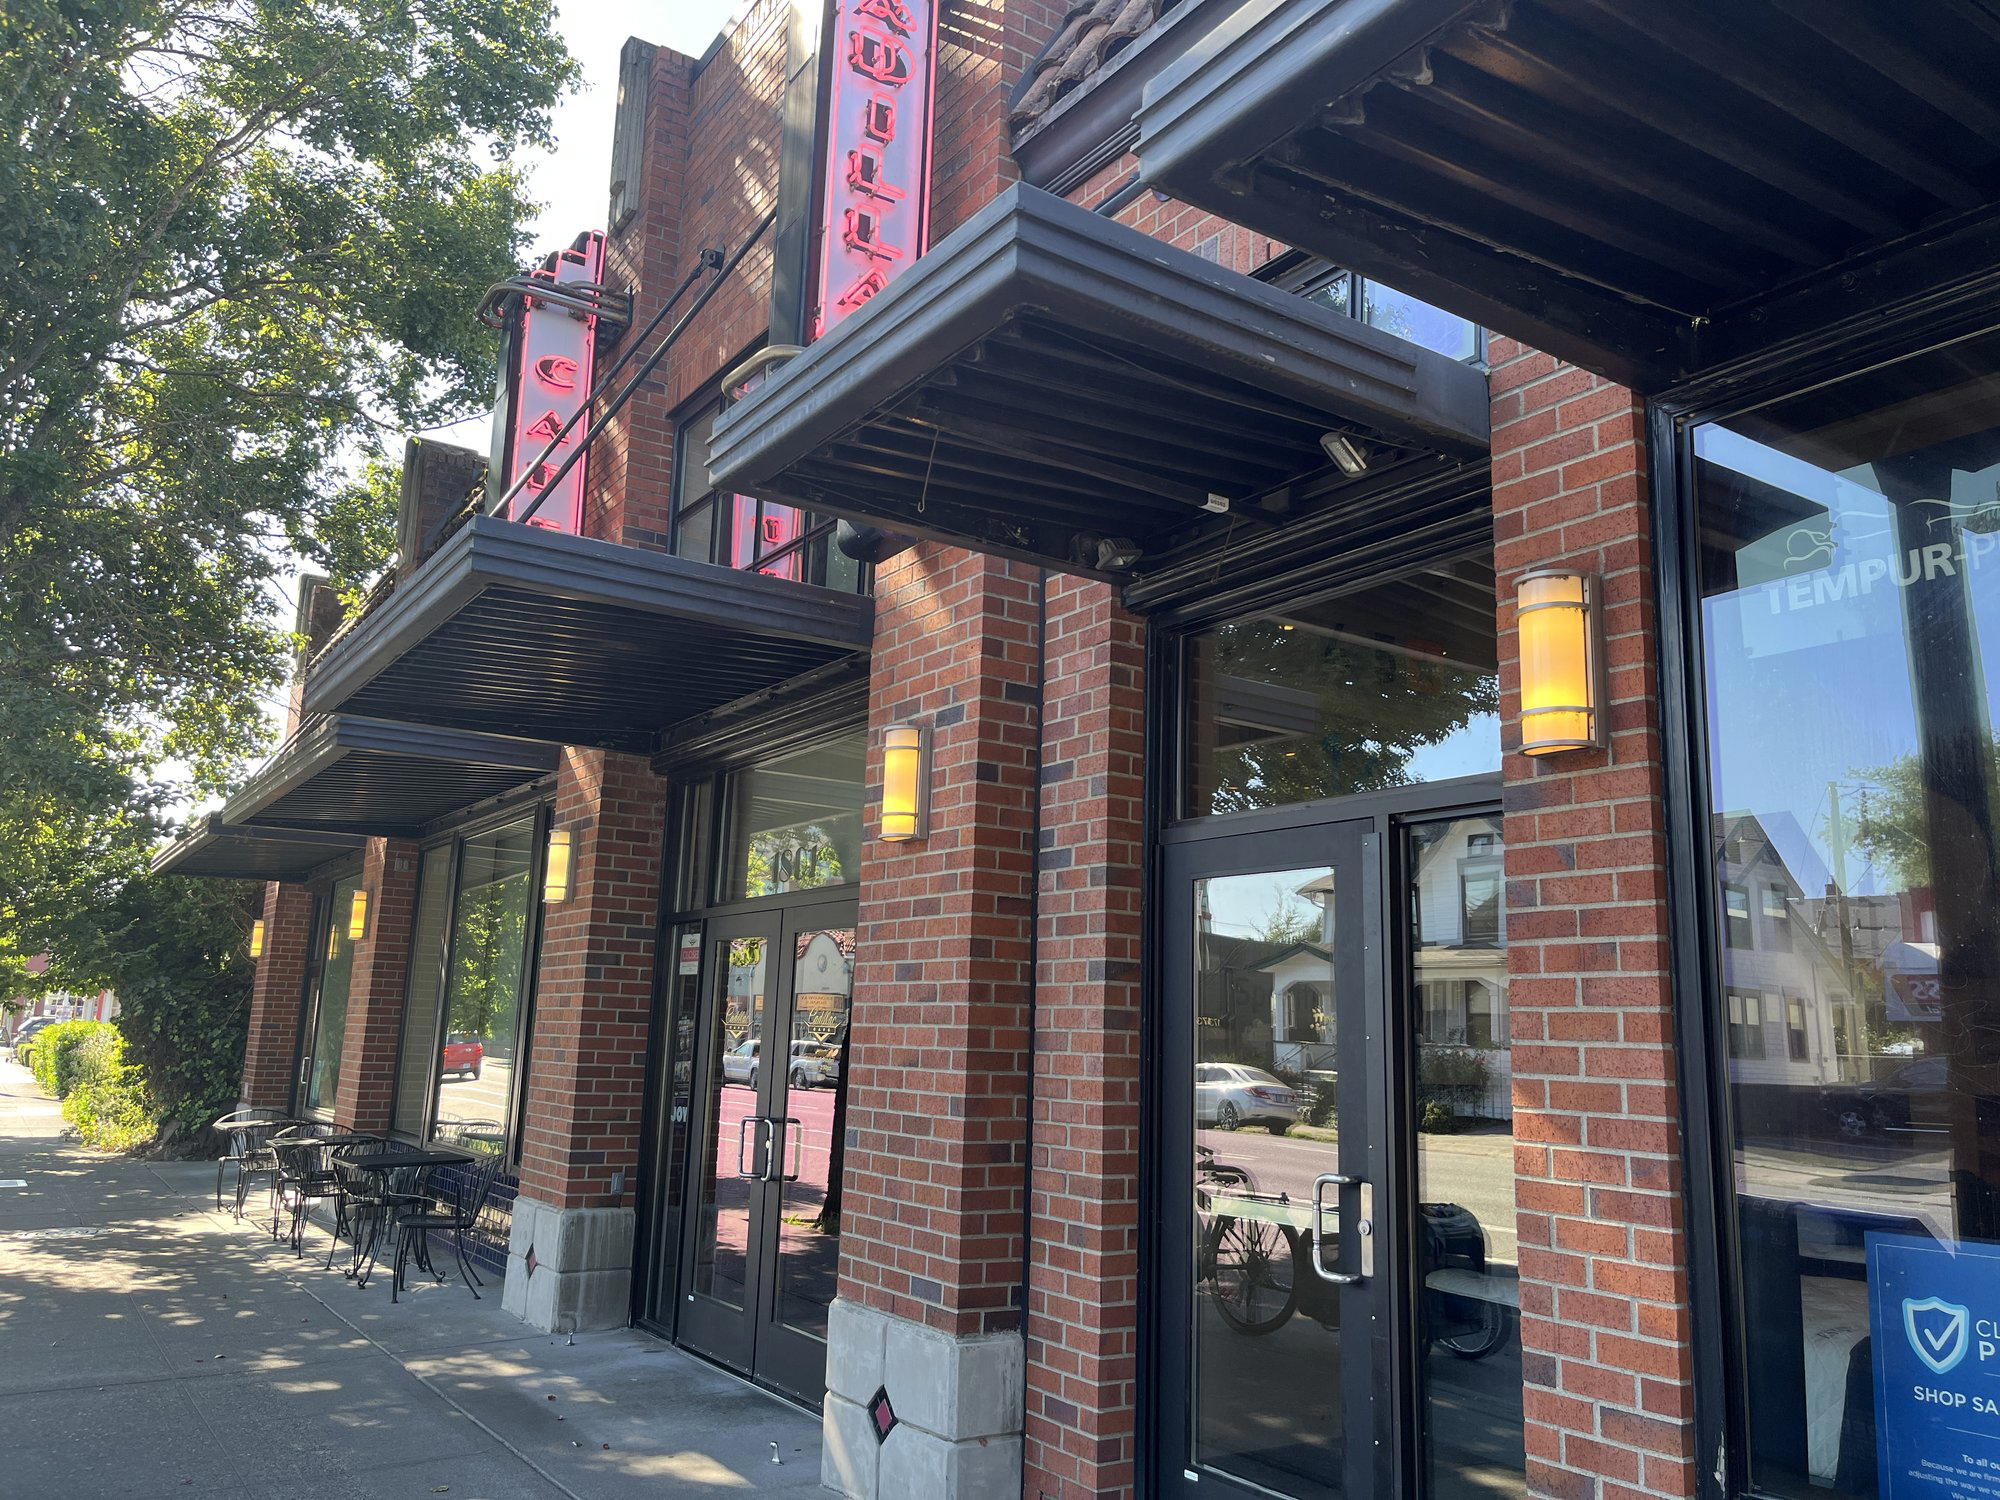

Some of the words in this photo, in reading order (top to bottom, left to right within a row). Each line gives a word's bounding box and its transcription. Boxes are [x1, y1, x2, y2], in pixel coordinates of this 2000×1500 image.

[1761, 534, 2000, 614] TEMPUR-P
[1979, 1340, 1996, 1361] P
[1914, 1385, 1967, 1408] SHOP
[1972, 1396, 1999, 1416] SA
[1921, 1458, 1954, 1473] Because
[1956, 1467, 1967, 1476] we
[1969, 1471, 1982, 1480] are
[1961, 1453, 1974, 1464] To
[1976, 1458, 1988, 1467] all
[1908, 1470, 1943, 1485] adjusting
[1945, 1478, 1958, 1487] the
[1960, 1481, 1976, 1492] way
[1978, 1486, 1990, 1495] we
